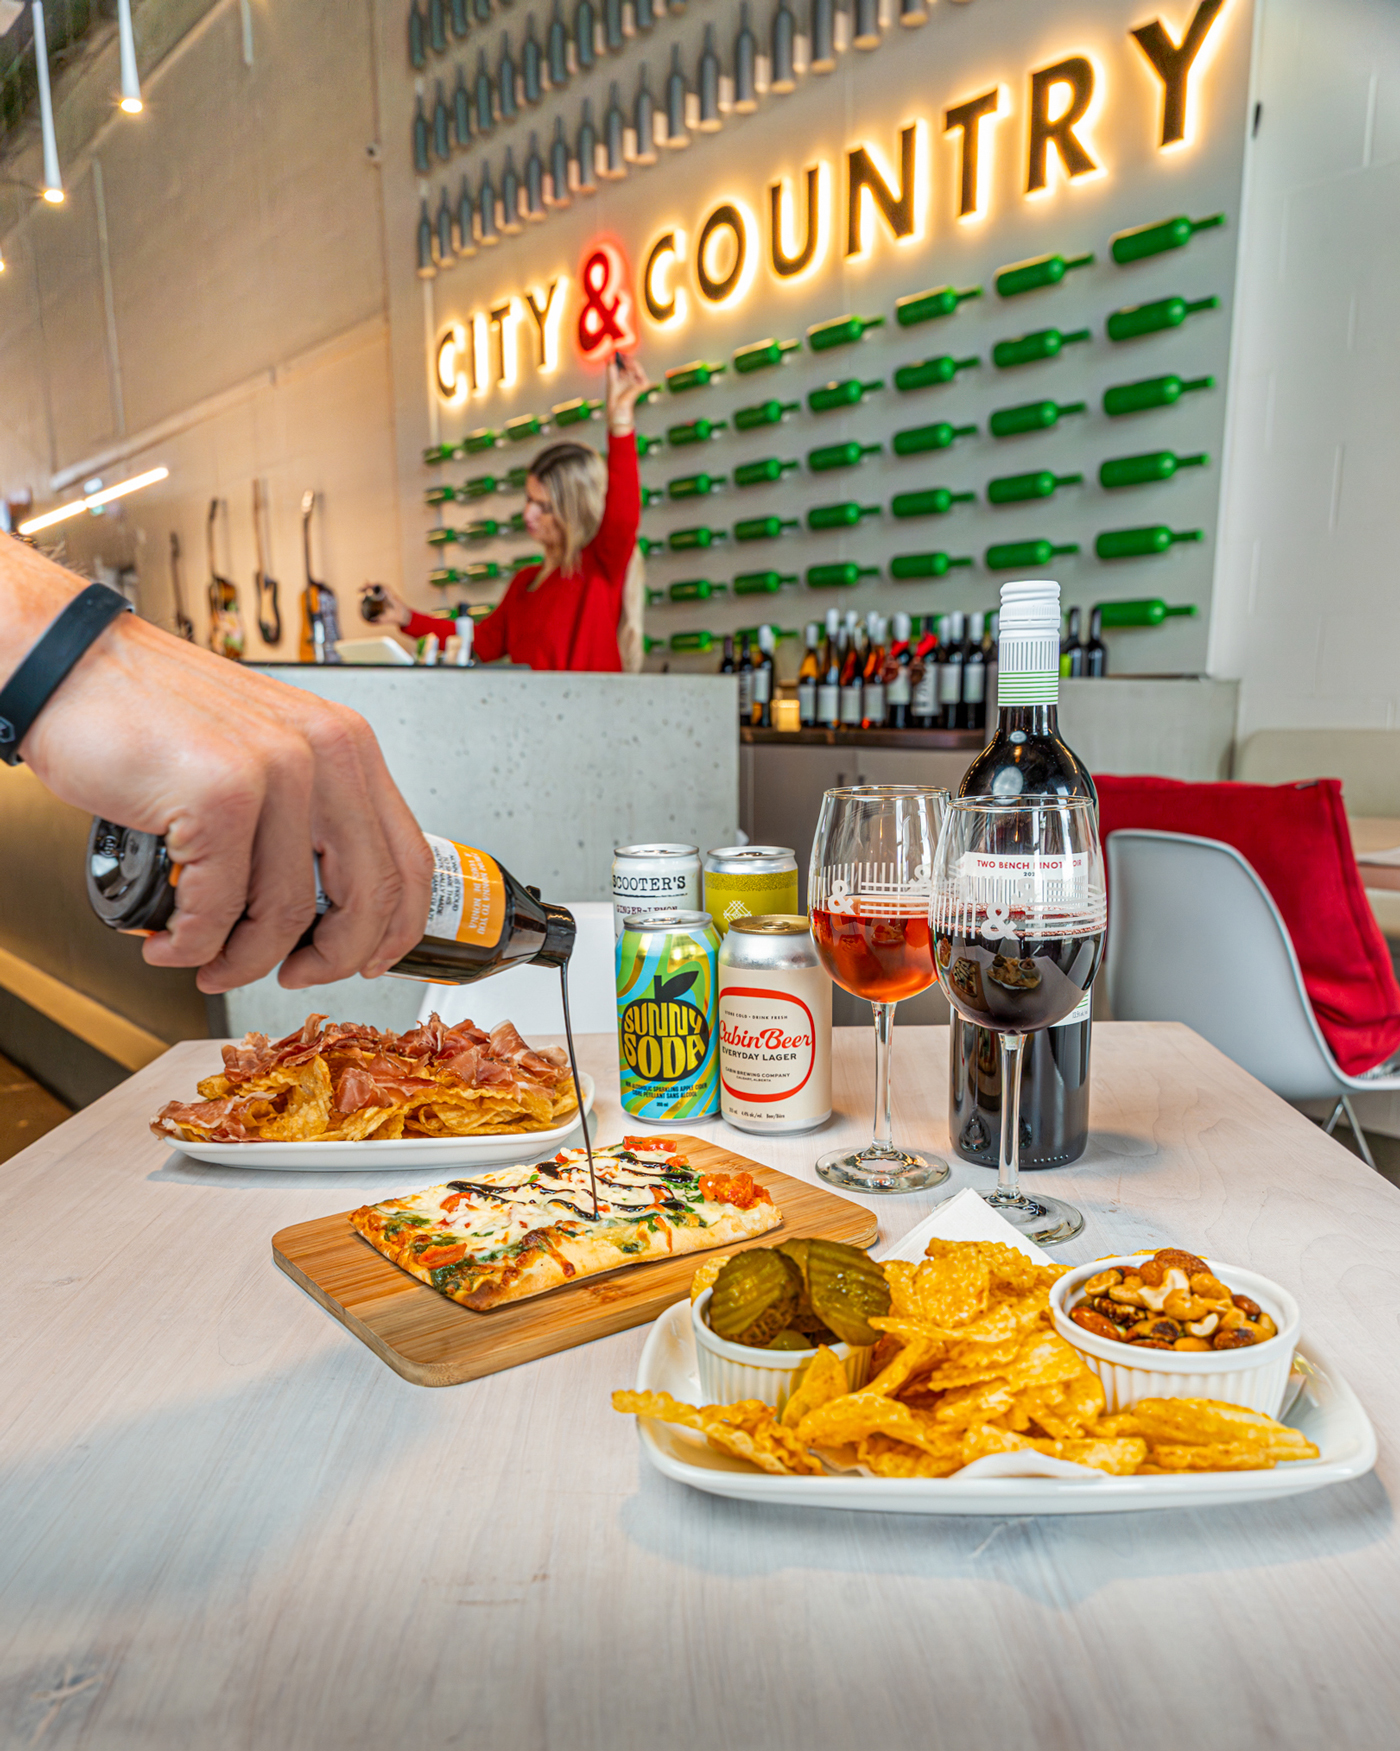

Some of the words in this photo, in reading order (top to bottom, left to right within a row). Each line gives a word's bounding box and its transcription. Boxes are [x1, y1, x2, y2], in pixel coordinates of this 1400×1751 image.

[436, 281, 561, 399] CITY
[577, 251, 629, 355] &
[644, 0, 1225, 322] COUNTRY
[977, 859, 996, 868] TWO
[999, 861, 1030, 869] BENCH
[612, 874, 686, 891] SCOOTER'S
[468, 897, 481, 929] NONNA
[481, 904, 491, 916] TO
[477, 917, 488, 935] YOU
[624, 1002, 703, 1036] SUNNY
[719, 1020, 763, 1049] Cabin
[759, 1028, 812, 1050] Beer
[624, 1033, 706, 1078] SODA
[722, 1046, 760, 1060] EVERYDAY
[762, 1053, 797, 1061] LAGER
[737, 1070, 760, 1078] BREWING
